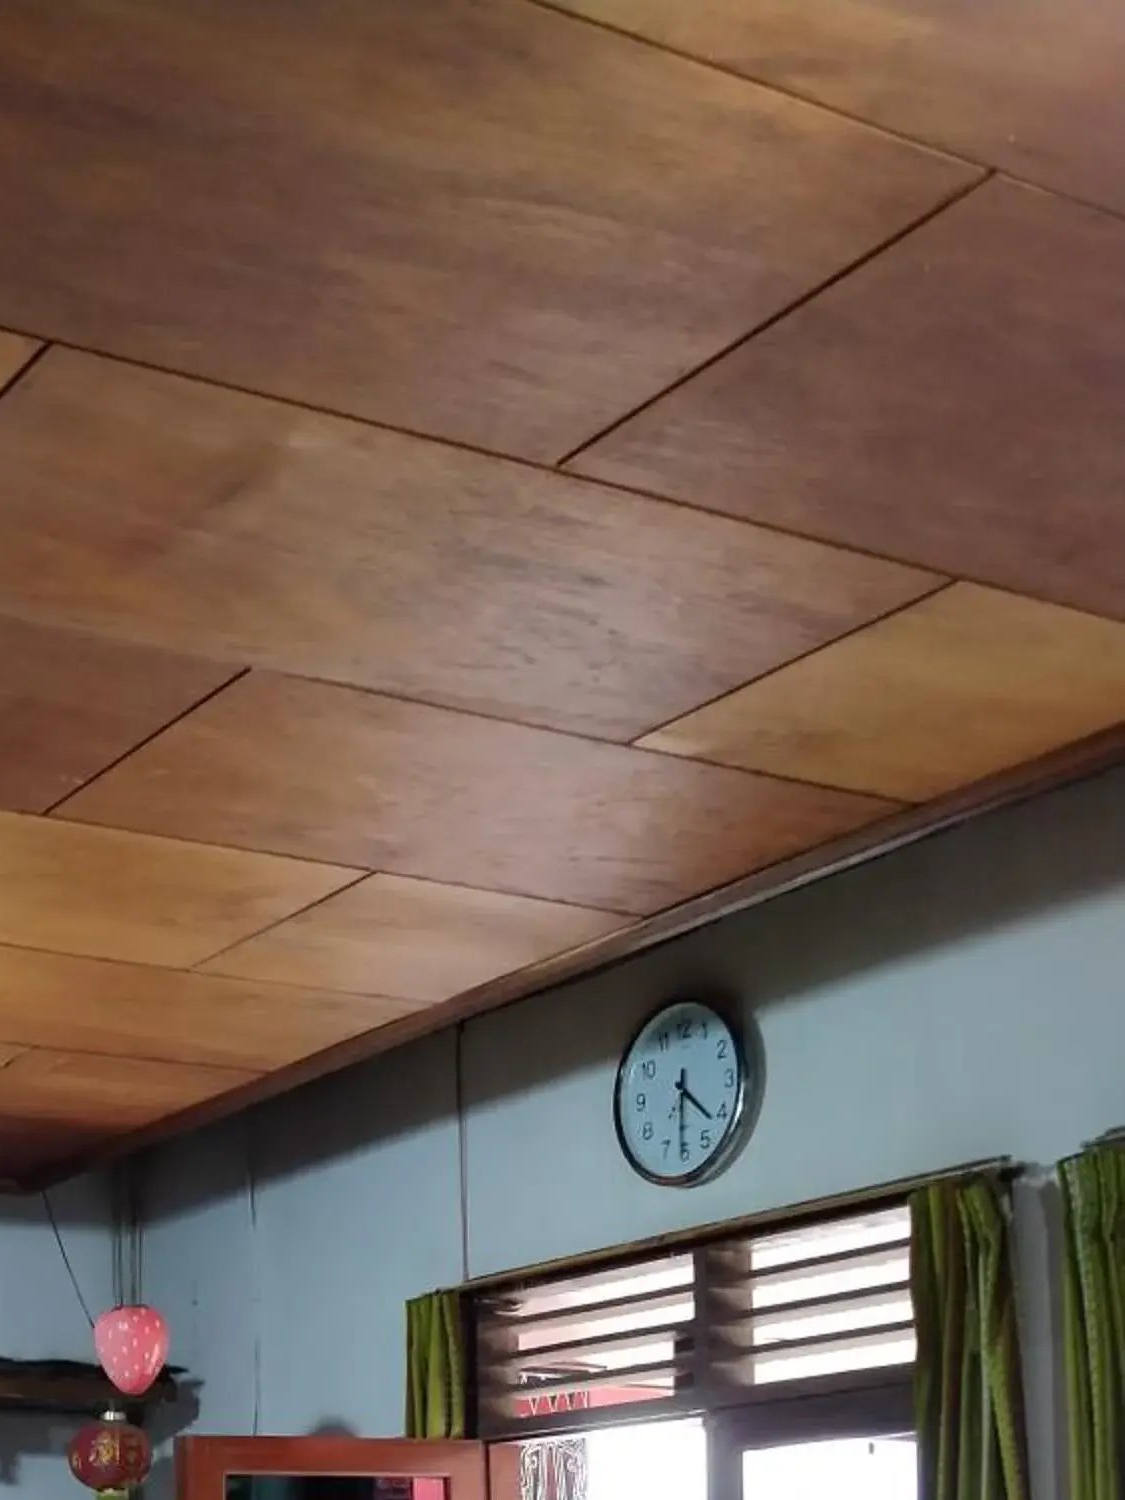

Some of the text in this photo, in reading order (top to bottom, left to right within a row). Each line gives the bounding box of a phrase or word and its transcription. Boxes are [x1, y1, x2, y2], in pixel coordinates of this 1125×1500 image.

[677, 1019, 691, 1040] 12
[700, 1021, 708, 1040] 1
[658, 1031, 670, 1052] 11
[717, 1039, 727, 1060] 2
[642, 1060, 656, 1080] 10
[725, 1069, 734, 1088] 3
[636, 1093, 646, 1112] 9
[717, 1103, 728, 1120] 4
[642, 1122, 654, 1141] 8
[700, 1130, 711, 1150] 5
[661, 1139, 671, 1159] 7
